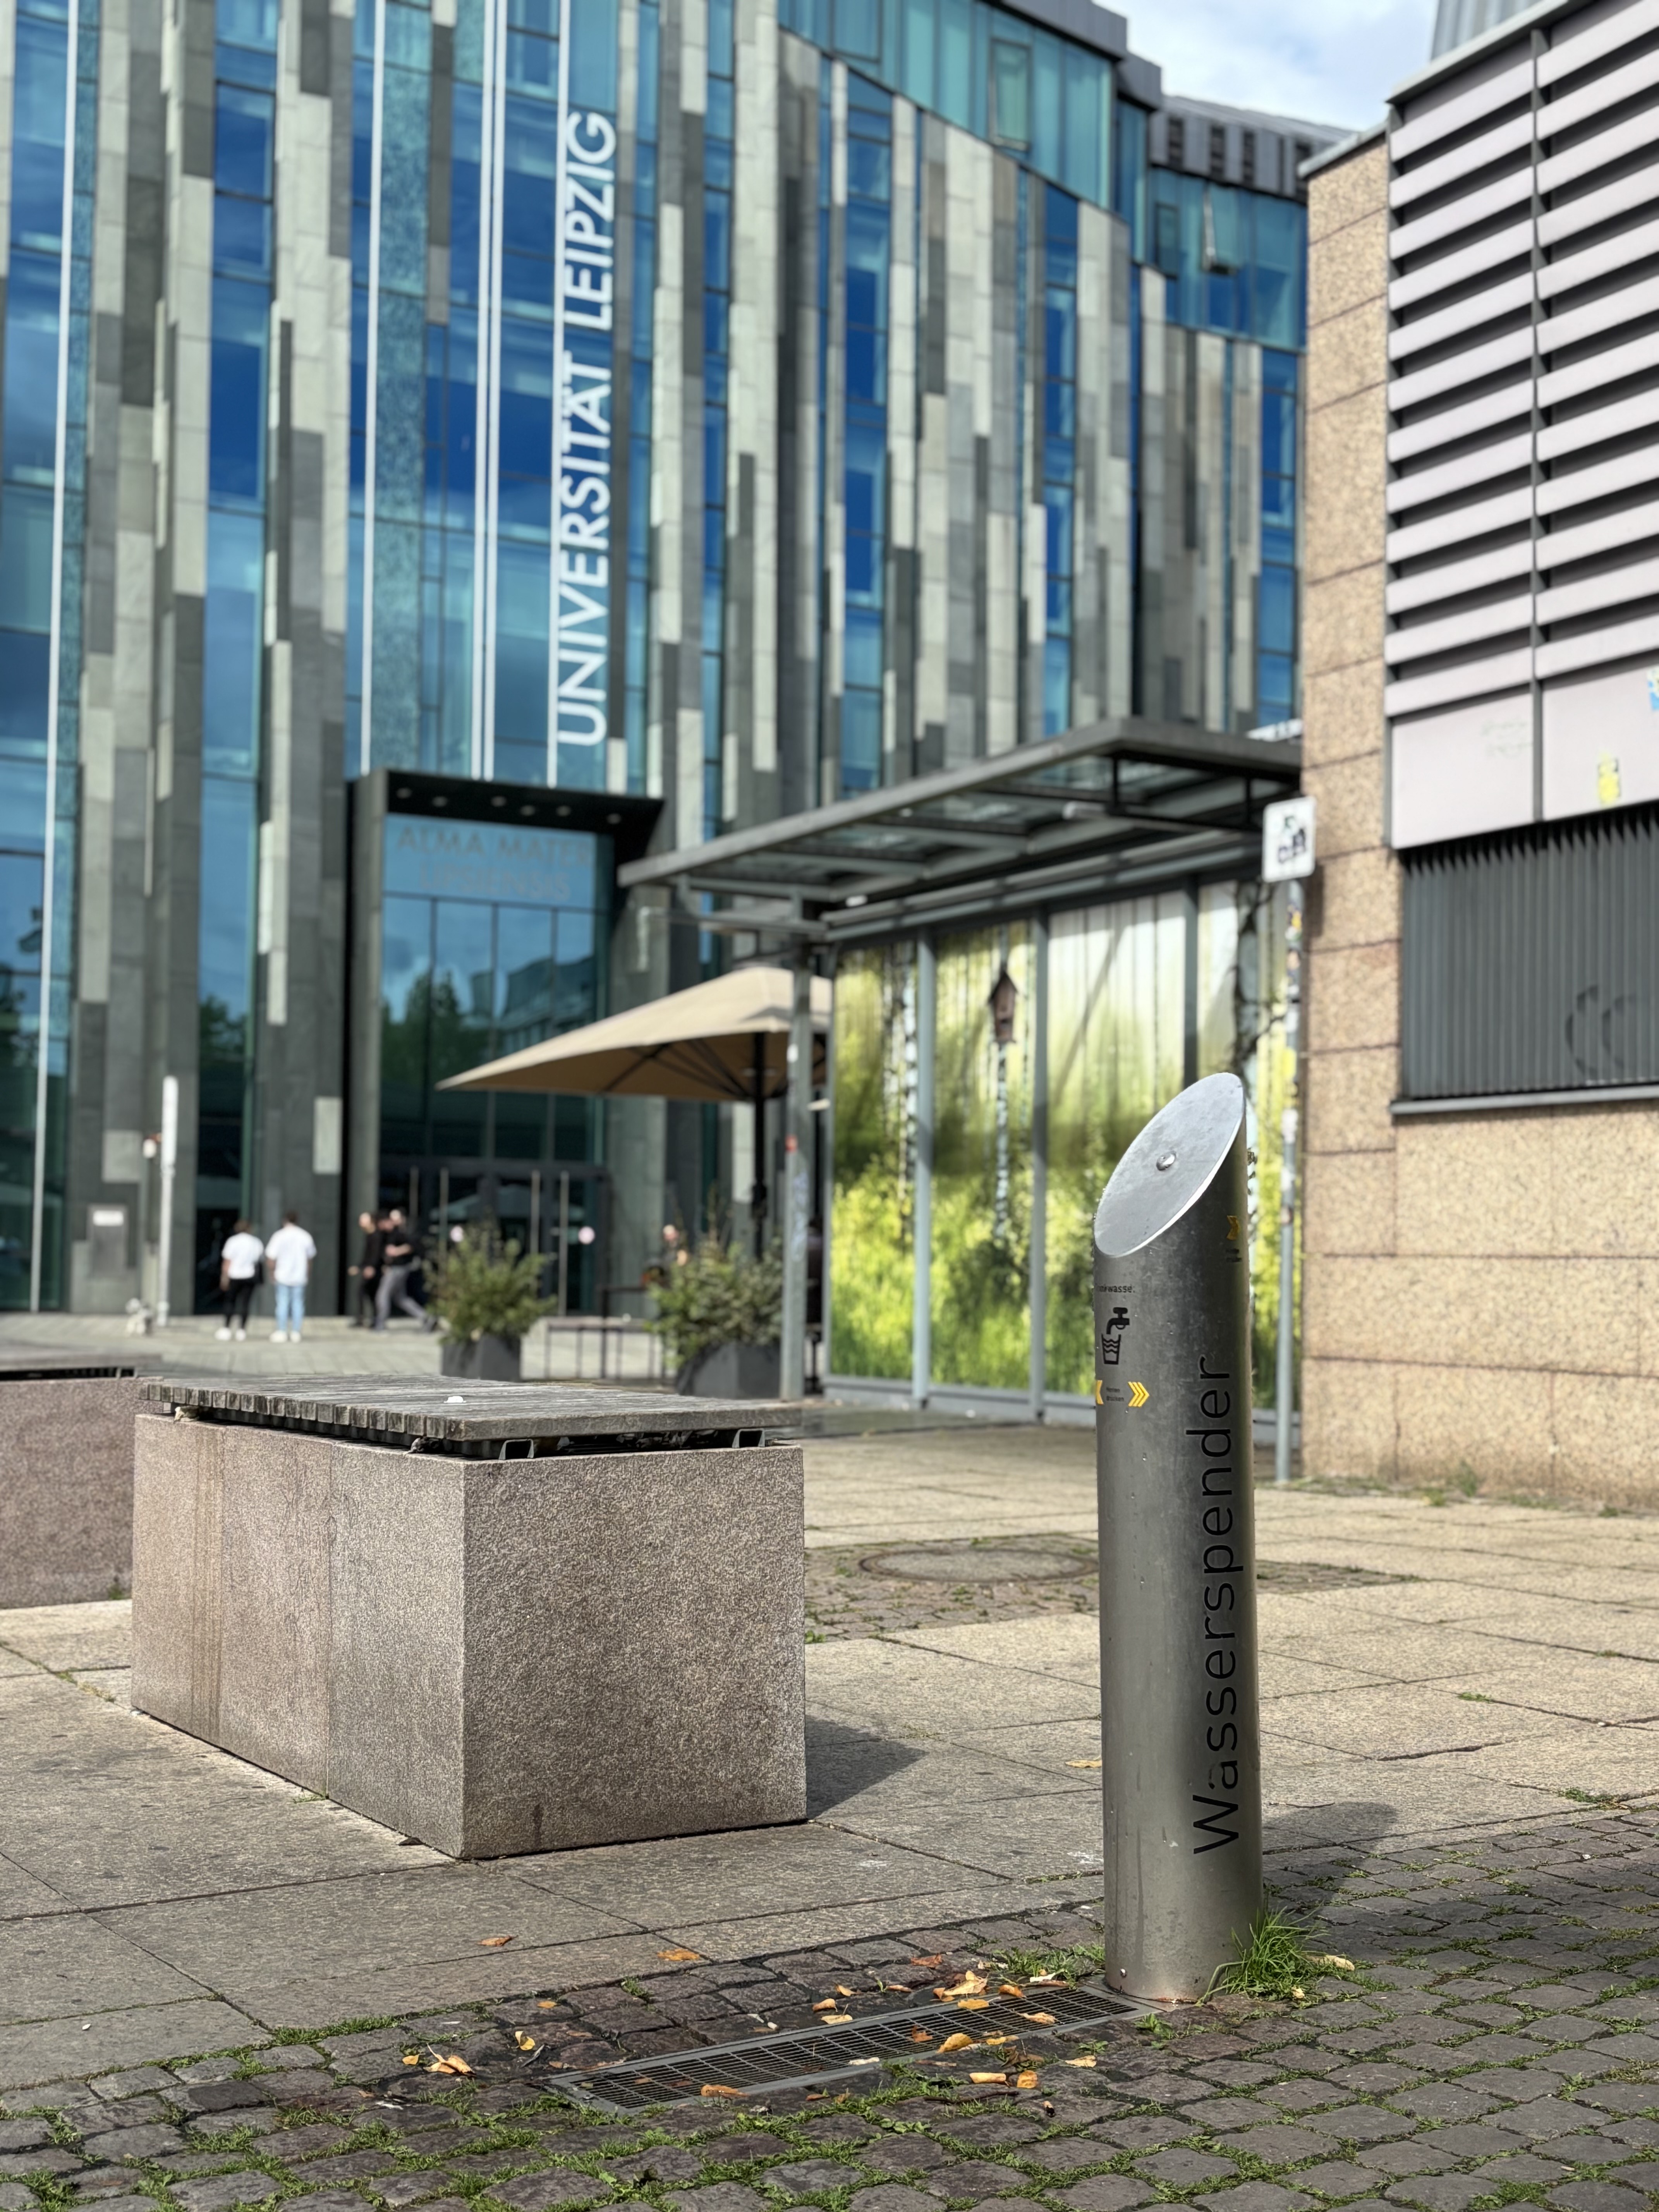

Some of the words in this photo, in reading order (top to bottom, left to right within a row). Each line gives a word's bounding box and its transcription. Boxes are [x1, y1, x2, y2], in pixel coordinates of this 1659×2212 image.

[564, 112, 616, 330] LEIPZIG
[558, 350, 611, 746] UNIVERSITÄT
[397, 826, 486, 858] ALMA
[496, 836, 590, 867] MATER
[1186, 1355, 1243, 1854] Wasserspender
